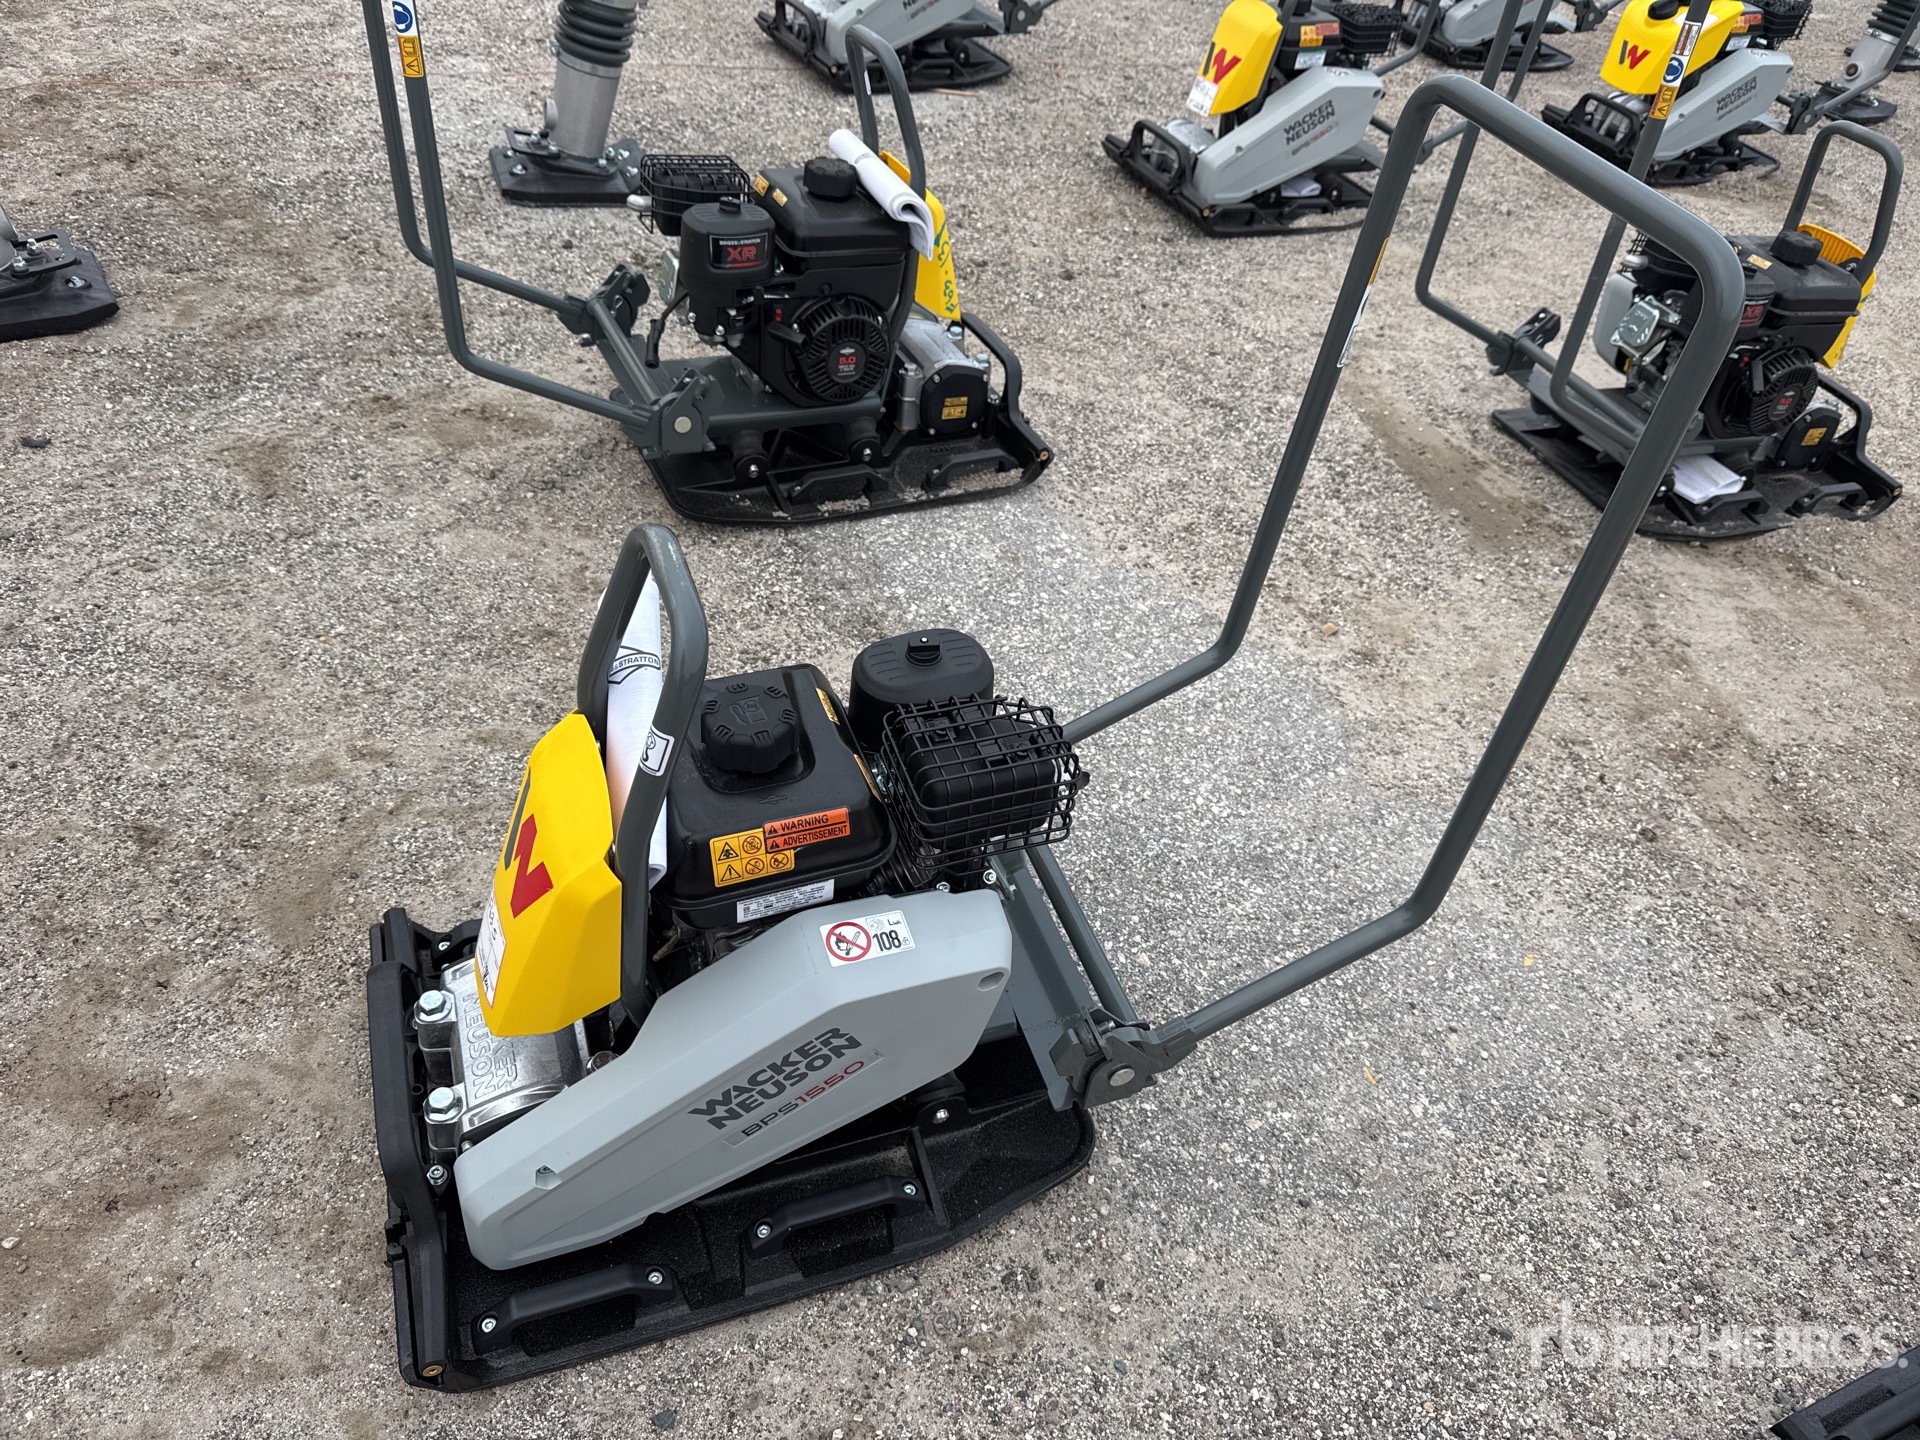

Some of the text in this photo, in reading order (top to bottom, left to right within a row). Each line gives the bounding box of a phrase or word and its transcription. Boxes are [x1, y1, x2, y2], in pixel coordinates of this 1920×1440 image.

[1717, 76, 1757, 105] WACKER
[1717, 83, 1757, 113] NEUSON
[1283, 99, 1333, 135] WACKER
[1285, 107, 1335, 145] NEUSON
[727, 246, 757, 261] XR
[781, 814, 829, 832] WARNING
[783, 824, 848, 847] ADVERTISSEMENT
[872, 929, 902, 952] 108
[687, 1027, 850, 1116] WACKER
[707, 1035, 862, 1130] NEUSON
[741, 1060, 865, 1137] BPS1550
